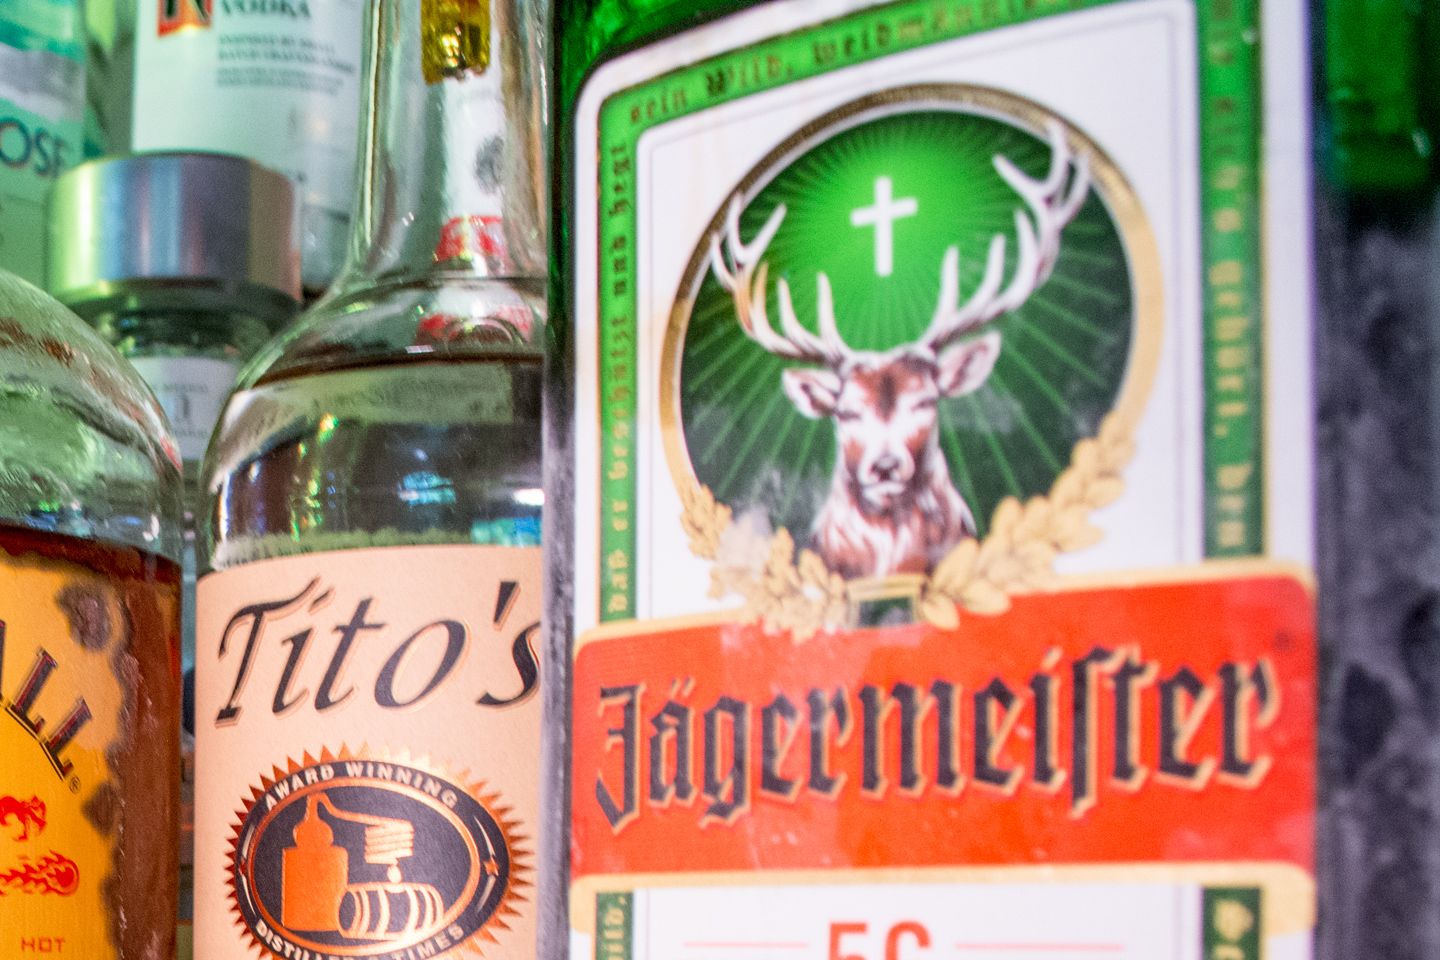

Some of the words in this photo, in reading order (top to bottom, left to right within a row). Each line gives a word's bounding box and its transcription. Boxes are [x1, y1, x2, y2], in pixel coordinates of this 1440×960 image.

[215, 575, 540, 729] Tito's
[264, 764, 335, 812] AWARD
[346, 760, 458, 808] WINNING
[595, 645, 1282, 835] Jägermeister
[21, 937, 67, 954] HOT
